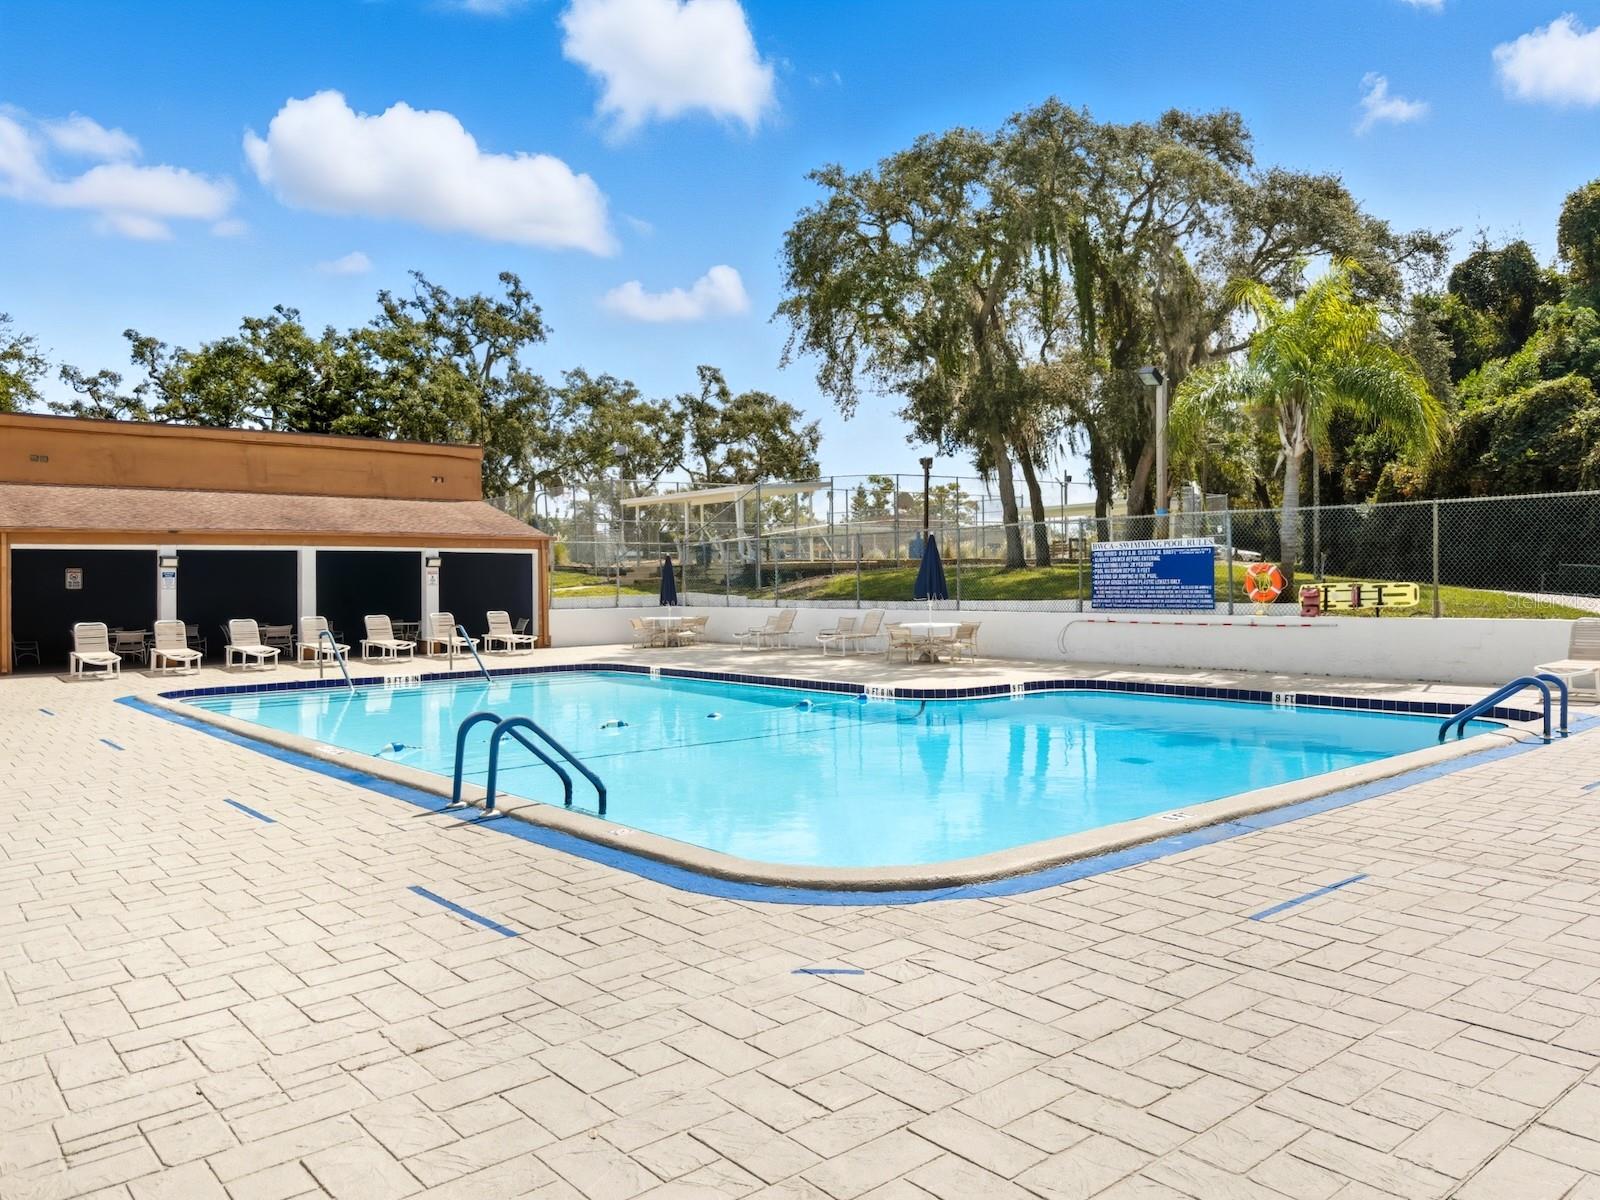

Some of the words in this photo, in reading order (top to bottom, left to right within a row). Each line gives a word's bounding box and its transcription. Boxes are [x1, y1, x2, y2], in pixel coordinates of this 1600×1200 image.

[1119, 540, 1162, 549] SWIMMING
[1164, 539, 1183, 547] POOL
[1187, 538, 1213, 546] RULES
[1285, 694, 1295, 704] FT
